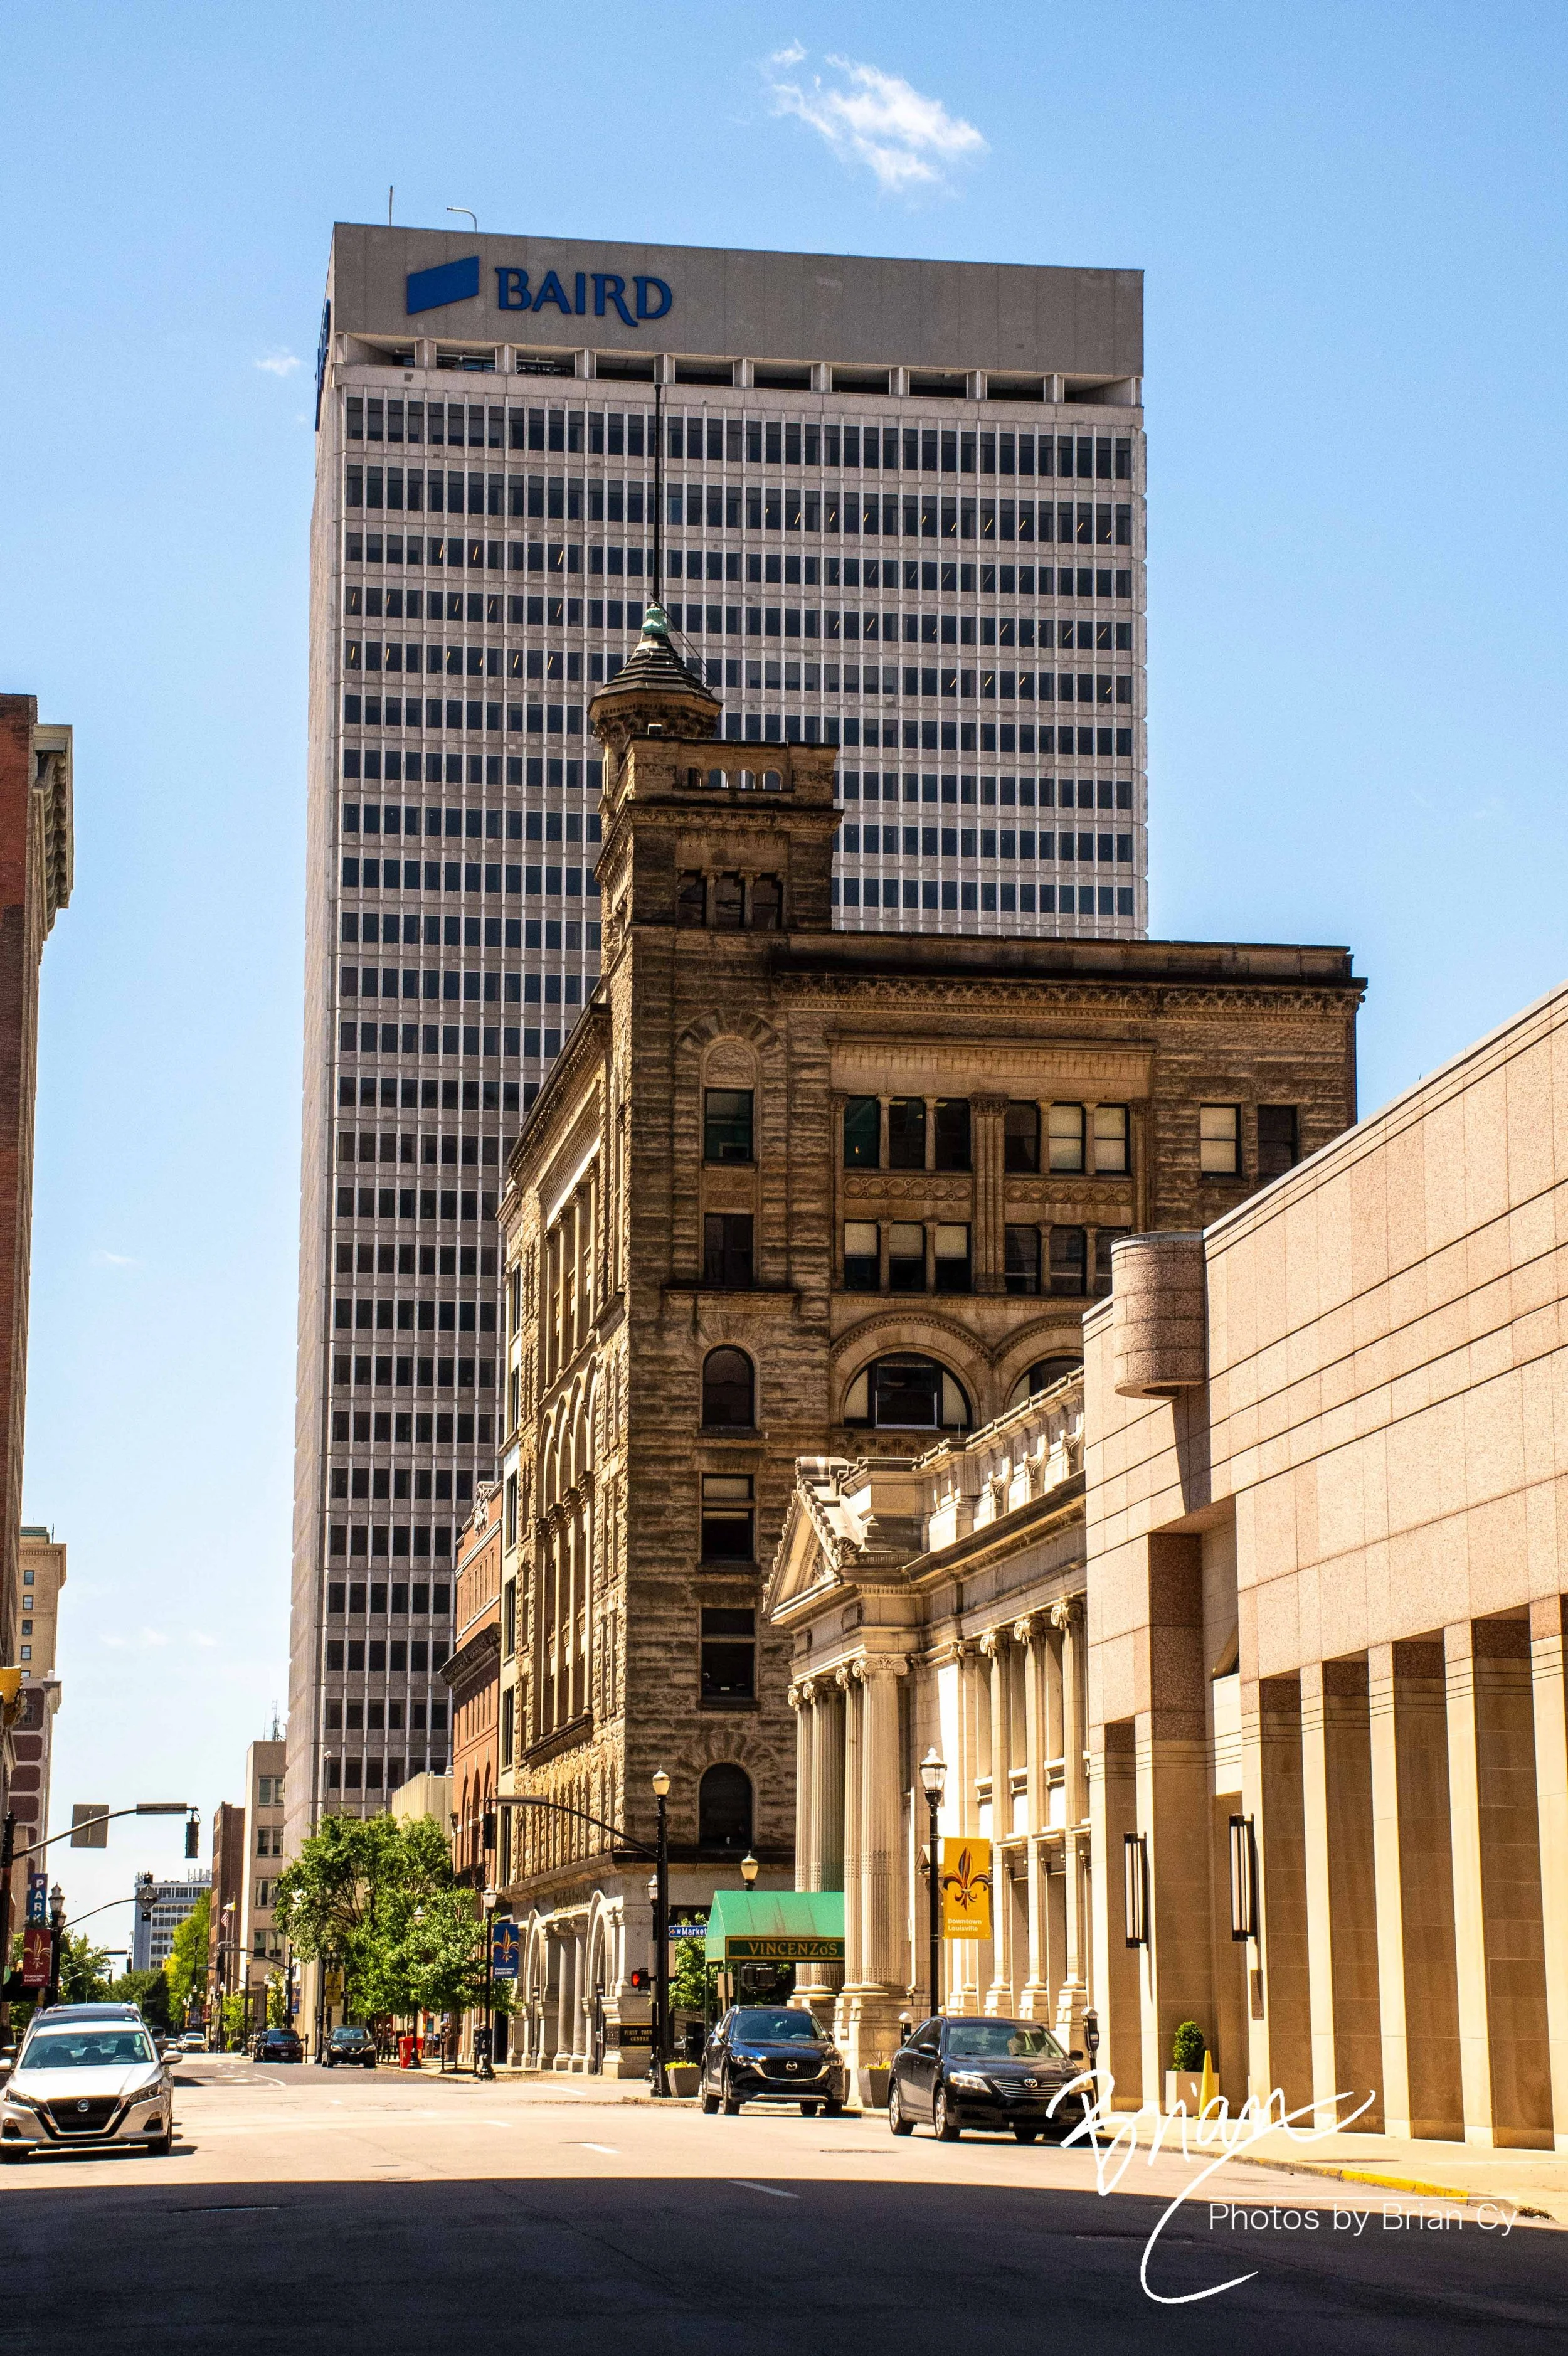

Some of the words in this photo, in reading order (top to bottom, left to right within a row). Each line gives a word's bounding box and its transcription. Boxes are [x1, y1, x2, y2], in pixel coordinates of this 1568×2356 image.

[495, 267, 672, 327] BAIRD
[33, 1879, 44, 1923] PARK
[682, 1928, 707, 1936] Market
